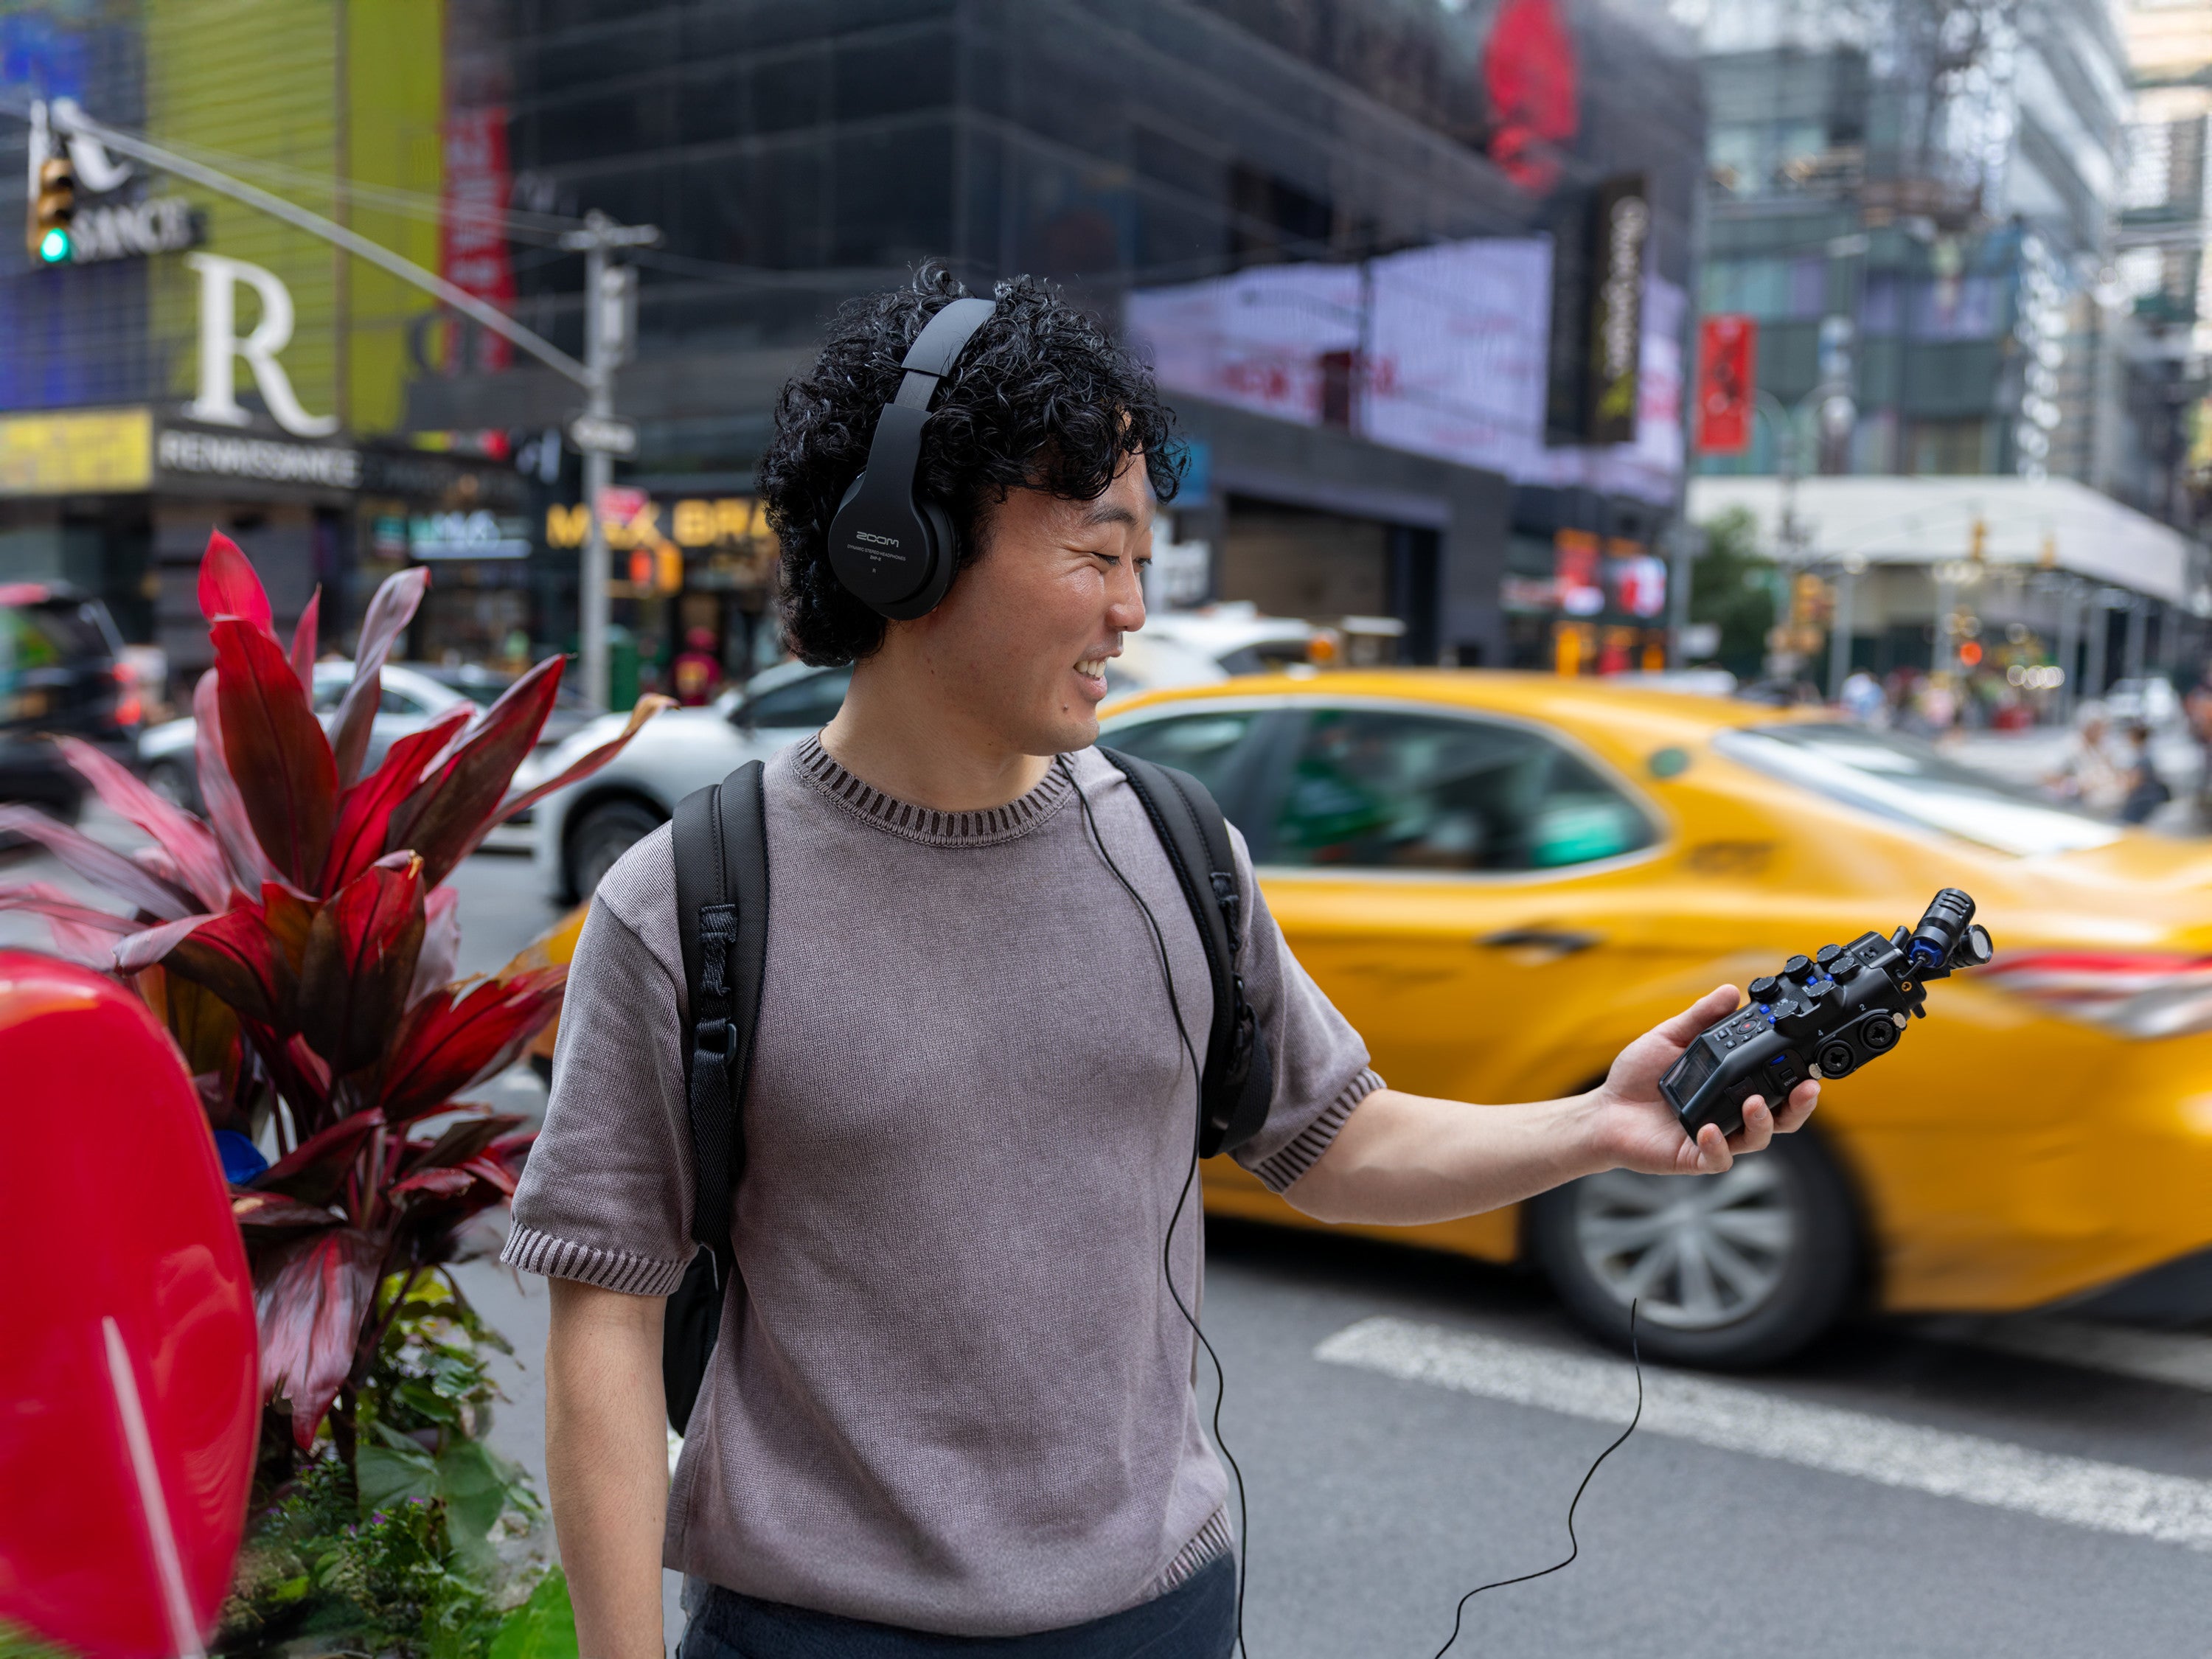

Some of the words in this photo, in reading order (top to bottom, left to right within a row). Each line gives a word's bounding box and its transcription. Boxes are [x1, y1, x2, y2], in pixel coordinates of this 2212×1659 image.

[184, 252, 339, 437] R
[856, 531, 899, 548] ZOOM
[846, 544, 864, 552] DYNAMIC
[880, 552, 906, 561] HEADPHONES
[1784, 1076, 1798, 1087] ENTER
